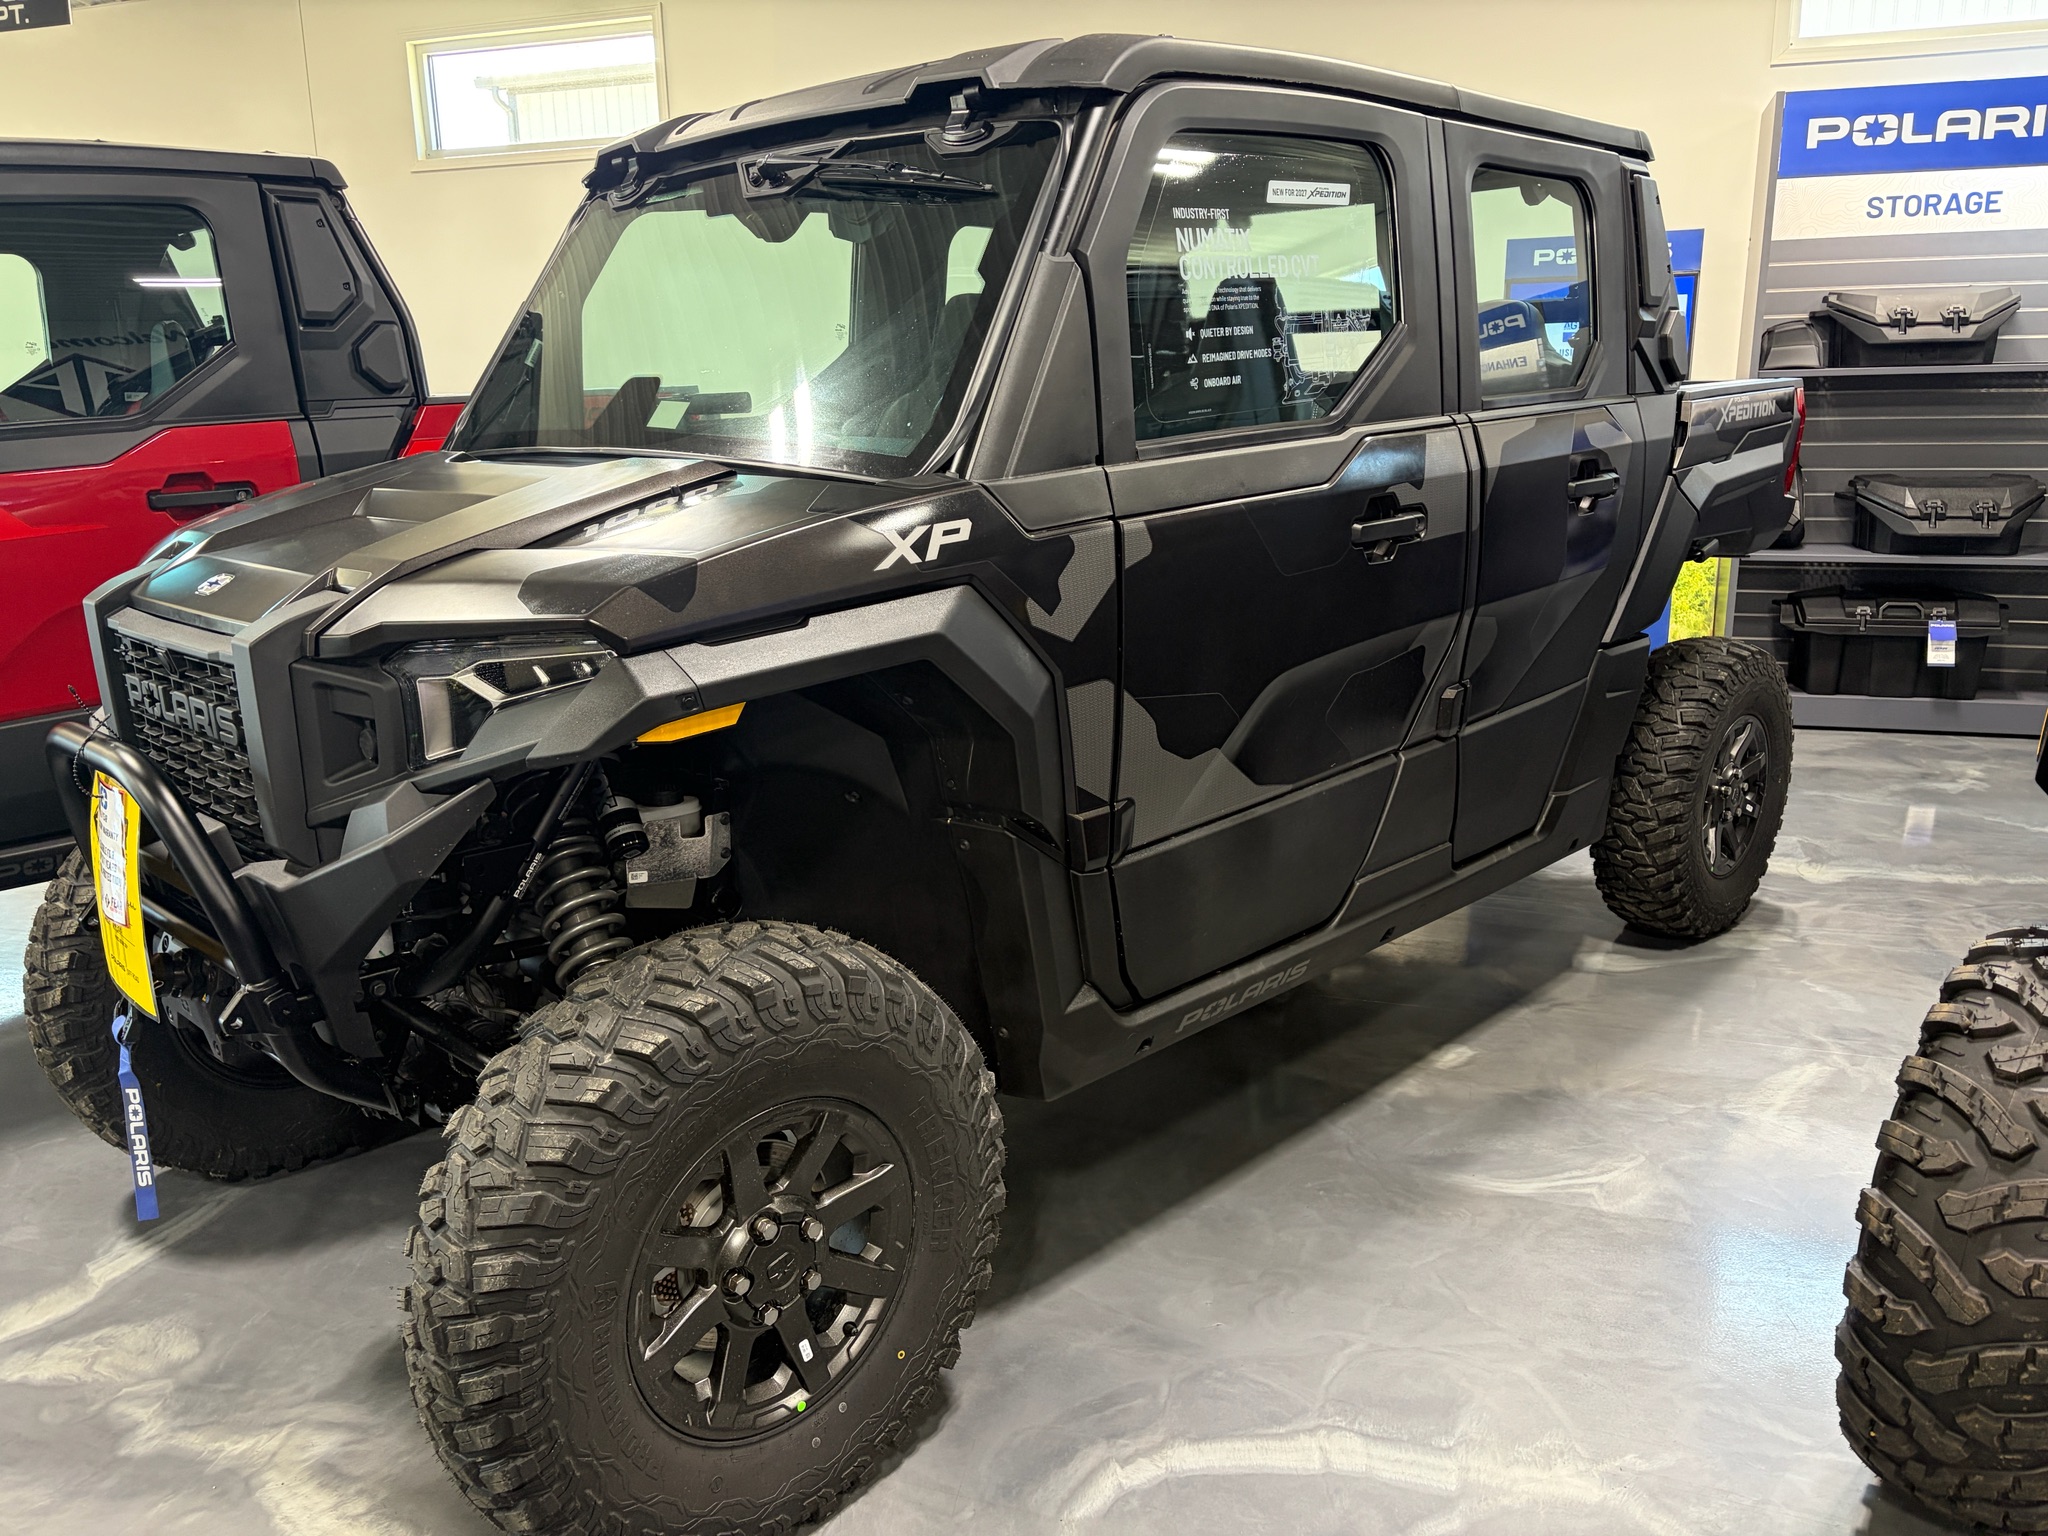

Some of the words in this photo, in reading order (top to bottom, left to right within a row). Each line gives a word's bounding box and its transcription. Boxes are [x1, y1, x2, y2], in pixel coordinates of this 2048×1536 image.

[1272, 188, 1284, 196] NEW
[1285, 188, 1295, 197] FOR
[1307, 187, 1347, 199] XPEDITION
[1866, 190, 2003, 218] STORAGE
[1173, 207, 1230, 220] INDUSTRY-FIRST
[1179, 254, 1289, 281] CONTROLLED
[1291, 254, 1320, 279] CVT
[1200, 327, 1224, 339] QUIETER
[1225, 327, 1233, 337] BY
[1233, 325, 1254, 336] DESIGN
[1202, 351, 1236, 363] REIMAGINED
[1237, 349, 1254, 360] DRIVE
[1254, 348, 1272, 358] MODES
[1203, 377, 1232, 388] ONBOARD
[1232, 375, 1242, 385] AIR
[1716, 398, 1777, 431] XPEDITION
[874, 518, 973, 571] XP
[123, 673, 239, 747] POLARIS
[513, 852, 542, 898] POLARIS
[1174, 958, 1312, 1034] POLARIS
[124, 1088, 152, 1187] POLARIS
